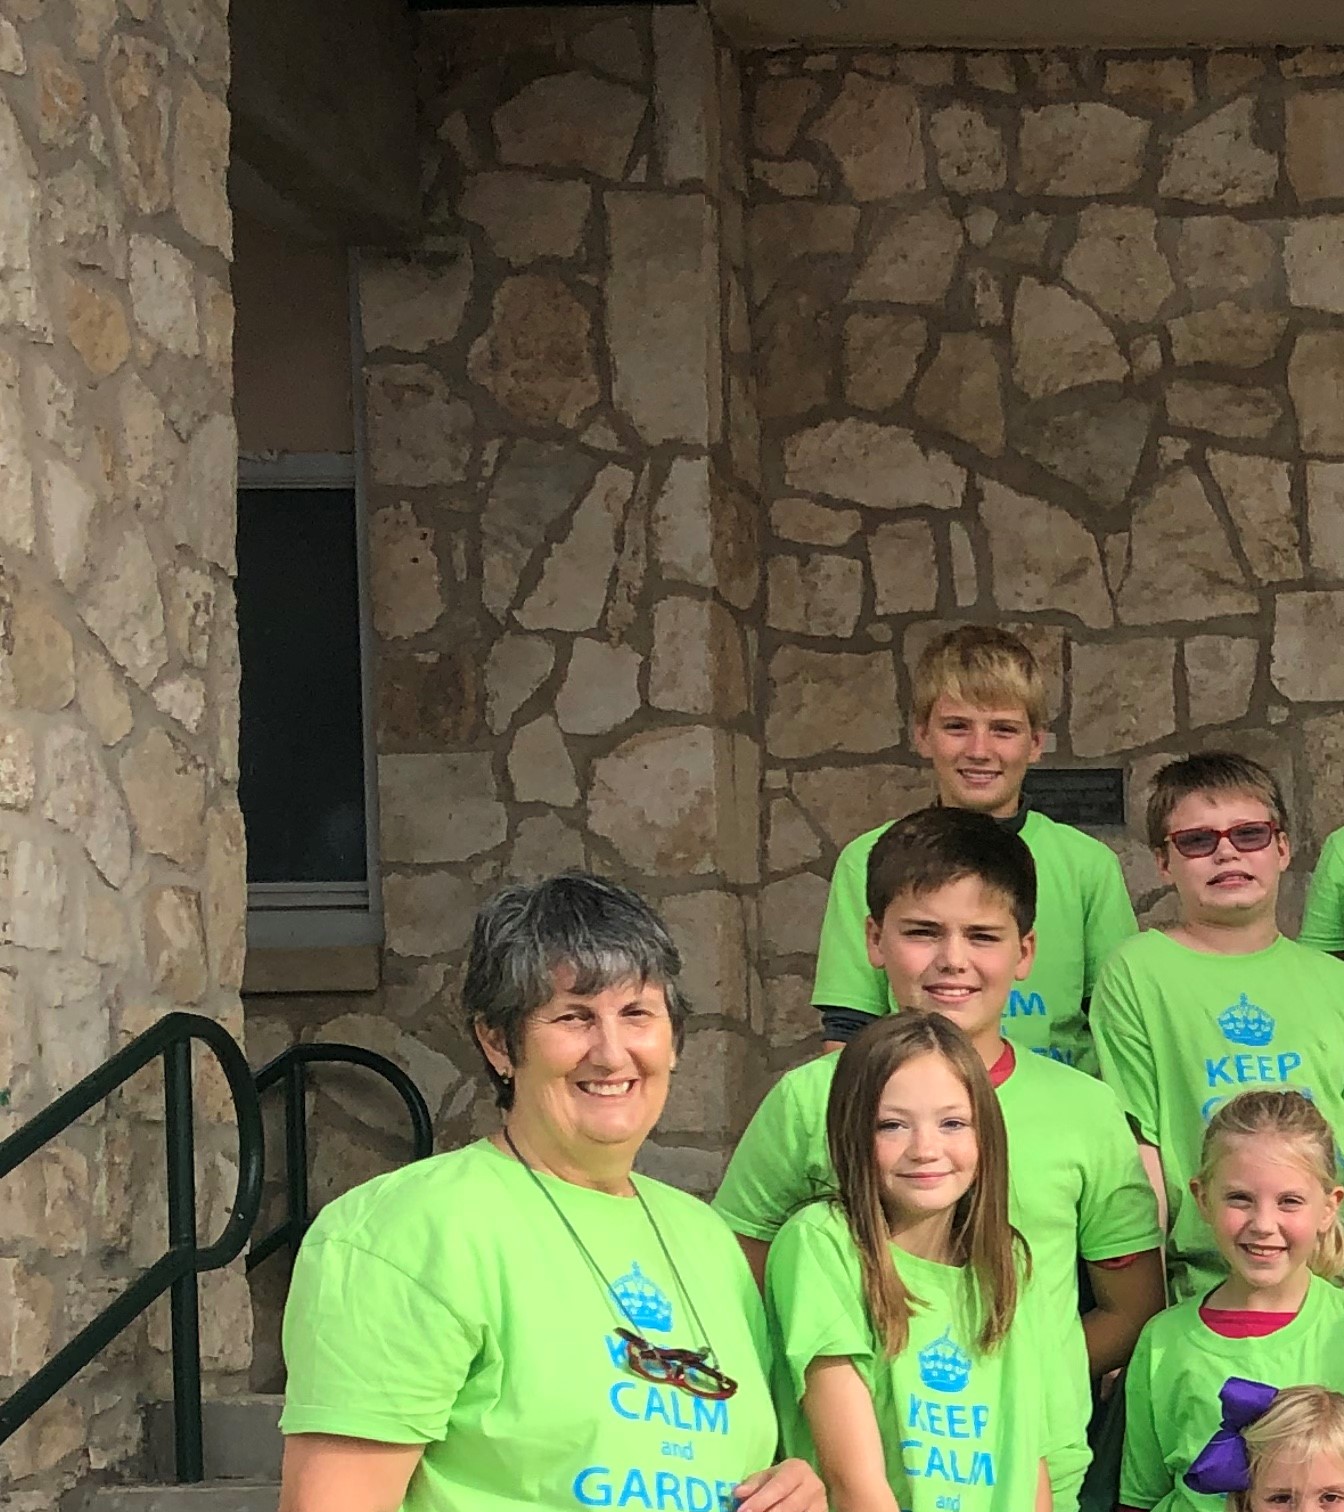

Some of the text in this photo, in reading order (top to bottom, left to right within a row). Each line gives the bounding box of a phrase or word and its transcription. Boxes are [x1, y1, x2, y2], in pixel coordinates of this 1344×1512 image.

[1205, 1052, 1302, 1088] KEEP
[609, 1381, 730, 1435] CALM
[908, 1394, 989, 1439] KEEP
[661, 1439, 694, 1460] and
[936, 1494, 961, 1512] and
